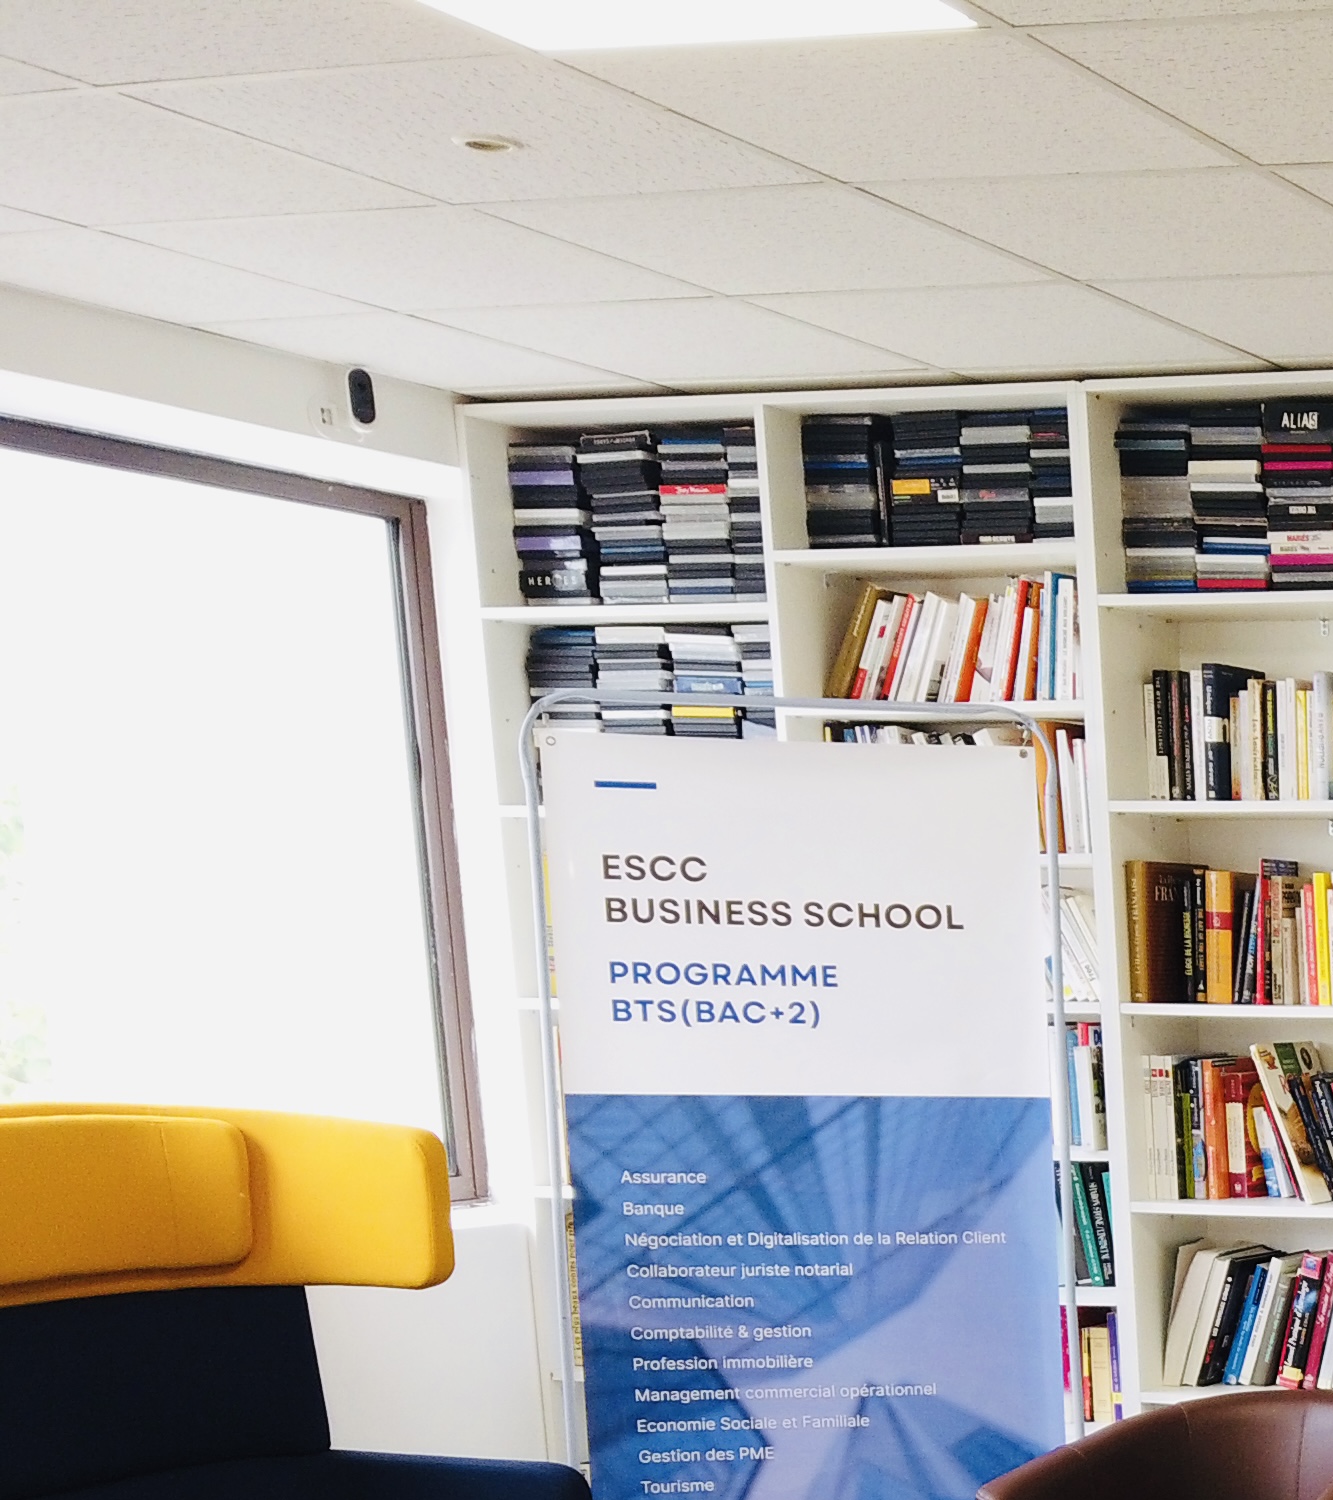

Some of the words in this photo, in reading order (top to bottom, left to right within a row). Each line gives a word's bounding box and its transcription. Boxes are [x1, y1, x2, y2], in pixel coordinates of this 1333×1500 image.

[1282, 412, 1318, 429] ALIAS
[602, 854, 708, 882] ESCC
[605, 897, 792, 927] BUSINESS
[804, 902, 964, 930] SCHOOL
[609, 961, 838, 987] PROGRAMME
[612, 999, 821, 1028] BTS(BAC+2)
[621, 1170, 706, 1185] Assurance
[623, 1201, 684, 1217] Banque
[625, 1231, 721, 1249] Négociation
[727, 1233, 743, 1246] et
[748, 1230, 848, 1248] Digitalisation
[853, 1231, 873, 1245] de
[878, 1231, 891, 1245] la
[896, 1230, 957, 1244] Relation
[962, 1230, 1006, 1244] Client
[627, 1263, 736, 1278] Collaborateur
[741, 1263, 790, 1278] juriste
[795, 1262, 853, 1276] notarial
[629, 1294, 754, 1309] Communication
[631, 1325, 733, 1343] Comptabilité
[739, 1326, 748, 1338] &
[753, 1324, 811, 1341] gestion
[633, 1356, 718, 1371] Profession
[722, 1354, 813, 1369] immobilière
[635, 1386, 740, 1404] Management
[745, 1385, 835, 1400] commercial
[840, 1383, 936, 1400] opérationnel
[637, 1419, 715, 1433] Economie
[721, 1417, 777, 1431] Sociale
[782, 1417, 798, 1430] et
[803, 1414, 870, 1429] Familiale
[639, 1449, 701, 1464] Gestion
[705, 1448, 734, 1462] des
[740, 1447, 774, 1460] PME
[641, 1479, 714, 1494] Tourisme
